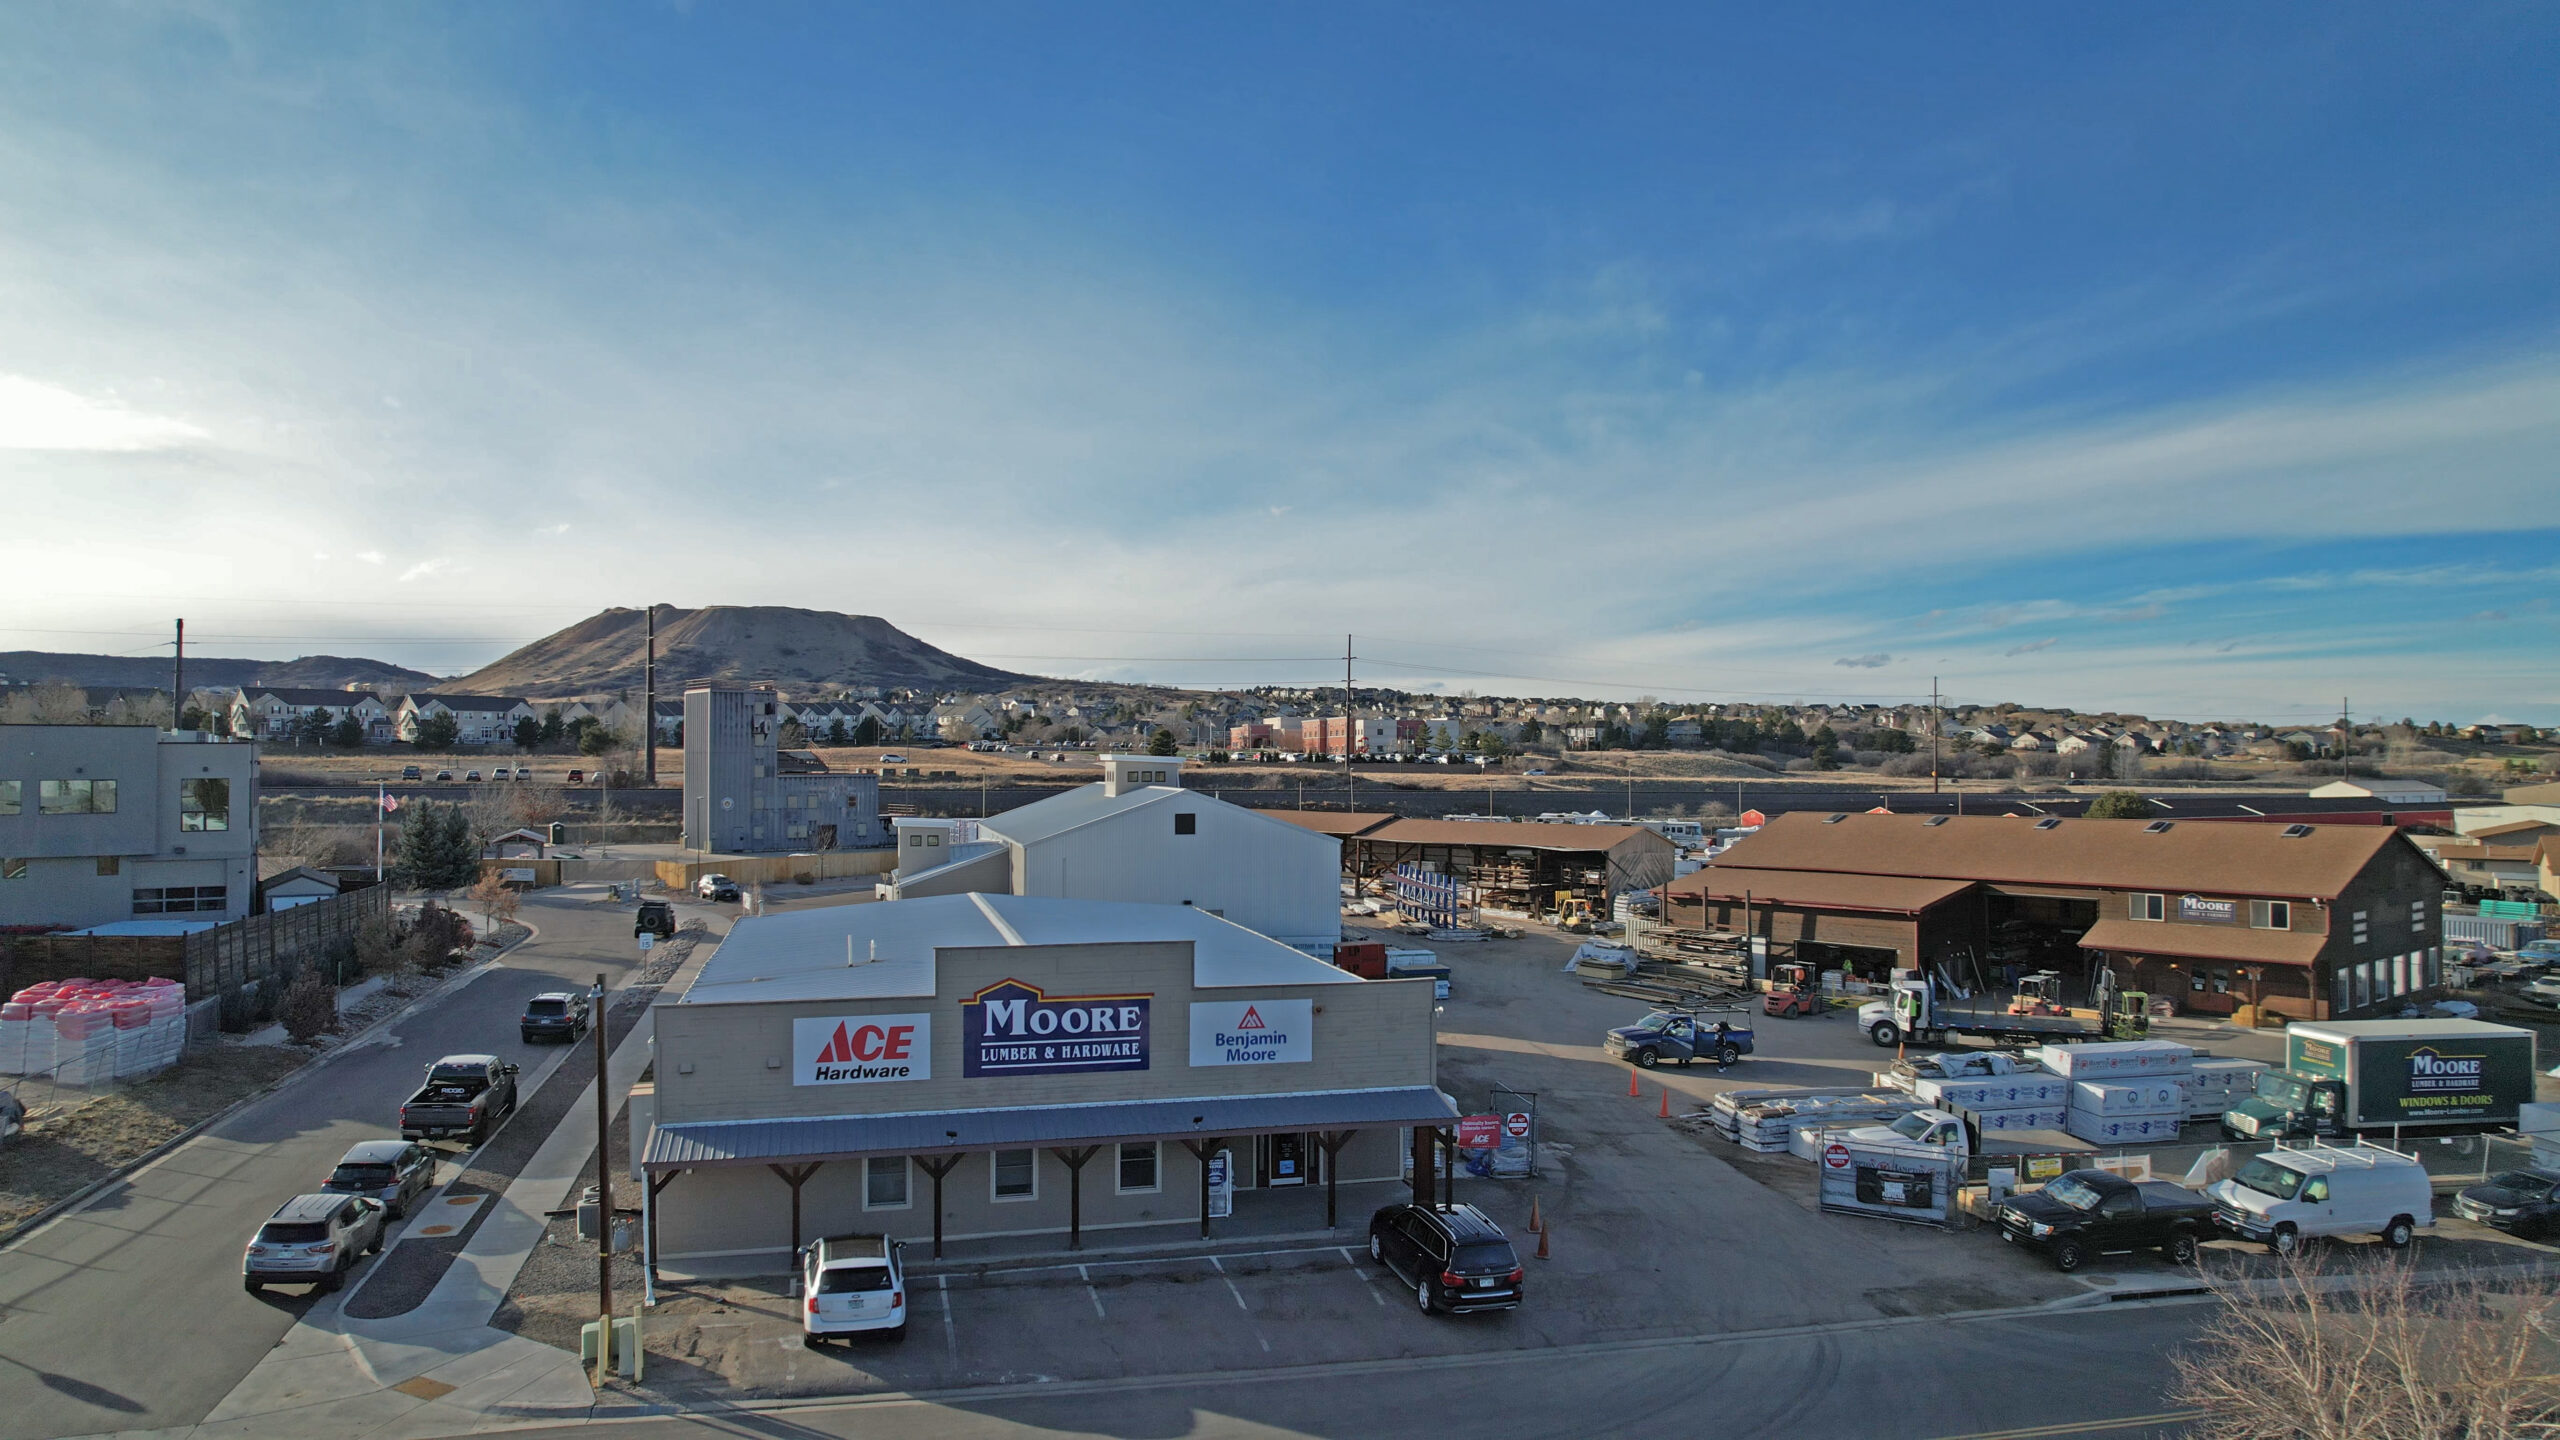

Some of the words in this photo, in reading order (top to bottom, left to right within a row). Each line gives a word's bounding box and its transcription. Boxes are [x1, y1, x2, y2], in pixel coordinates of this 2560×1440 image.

[2183, 898, 2232, 911] MOORE
[642, 941, 650, 949] 15
[983, 999, 1142, 1037] MOORE
[815, 1019, 915, 1063] ACE
[1216, 1030, 1287, 1049] Benjamin
[981, 1046, 1037, 1062] LUMBER
[1044, 1046, 1055, 1059] &
[1062, 1042, 1140, 1058] HARDWARE
[1226, 1048, 1277, 1062] Moore
[2413, 1055, 2481, 1075] MOORE
[815, 1065, 910, 1081] Hardware
[2411, 1080, 2437, 1088] LUMBER
[2399, 1096, 2449, 1107] WINDOWS
[2450, 1096, 2458, 1106] &
[2460, 1094, 2493, 1105] DOORS
[1471, 1134, 1490, 1143] ACE
